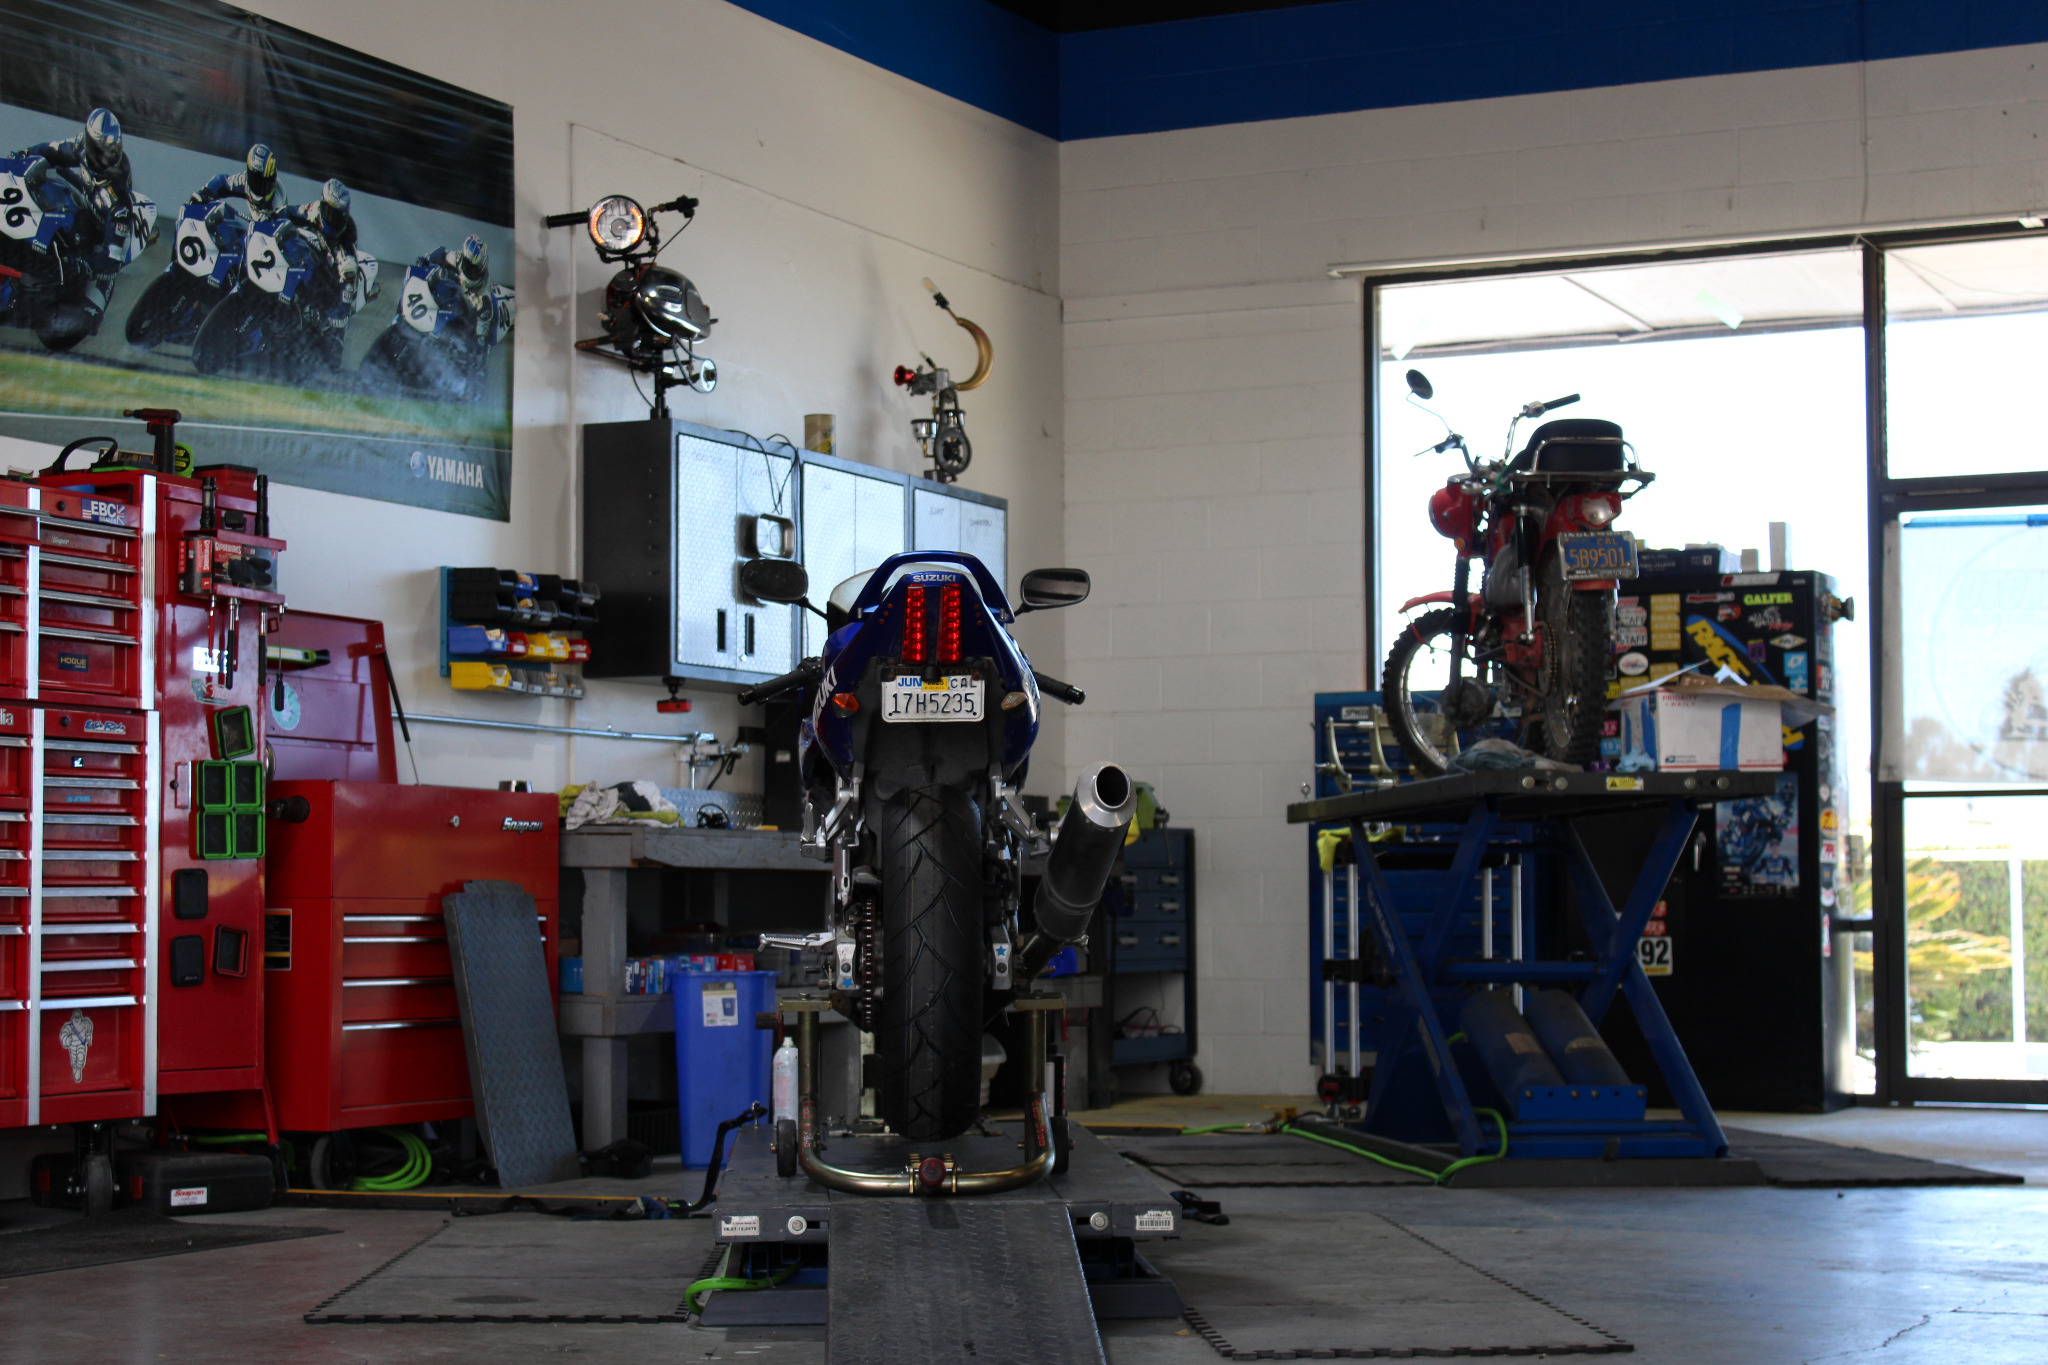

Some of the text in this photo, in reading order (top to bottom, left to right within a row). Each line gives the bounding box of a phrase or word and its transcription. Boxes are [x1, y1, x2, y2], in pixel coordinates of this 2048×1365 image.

[180, 236, 207, 266] 6
[251, 249, 276, 280] 2
[407, 292, 428, 320] 40
[427, 455, 484, 489] YAMAHA
[91, 500, 117, 518] EBC
[913, 574, 957, 583] SUZUKI
[1744, 592, 1794, 606] GALFER
[60, 656, 87, 666] HOGUE
[897, 677, 923, 687] JUN
[950, 677, 977, 689] CAL
[892, 693, 975, 714] 17H5235
[503, 816, 543, 834] Snap-on
